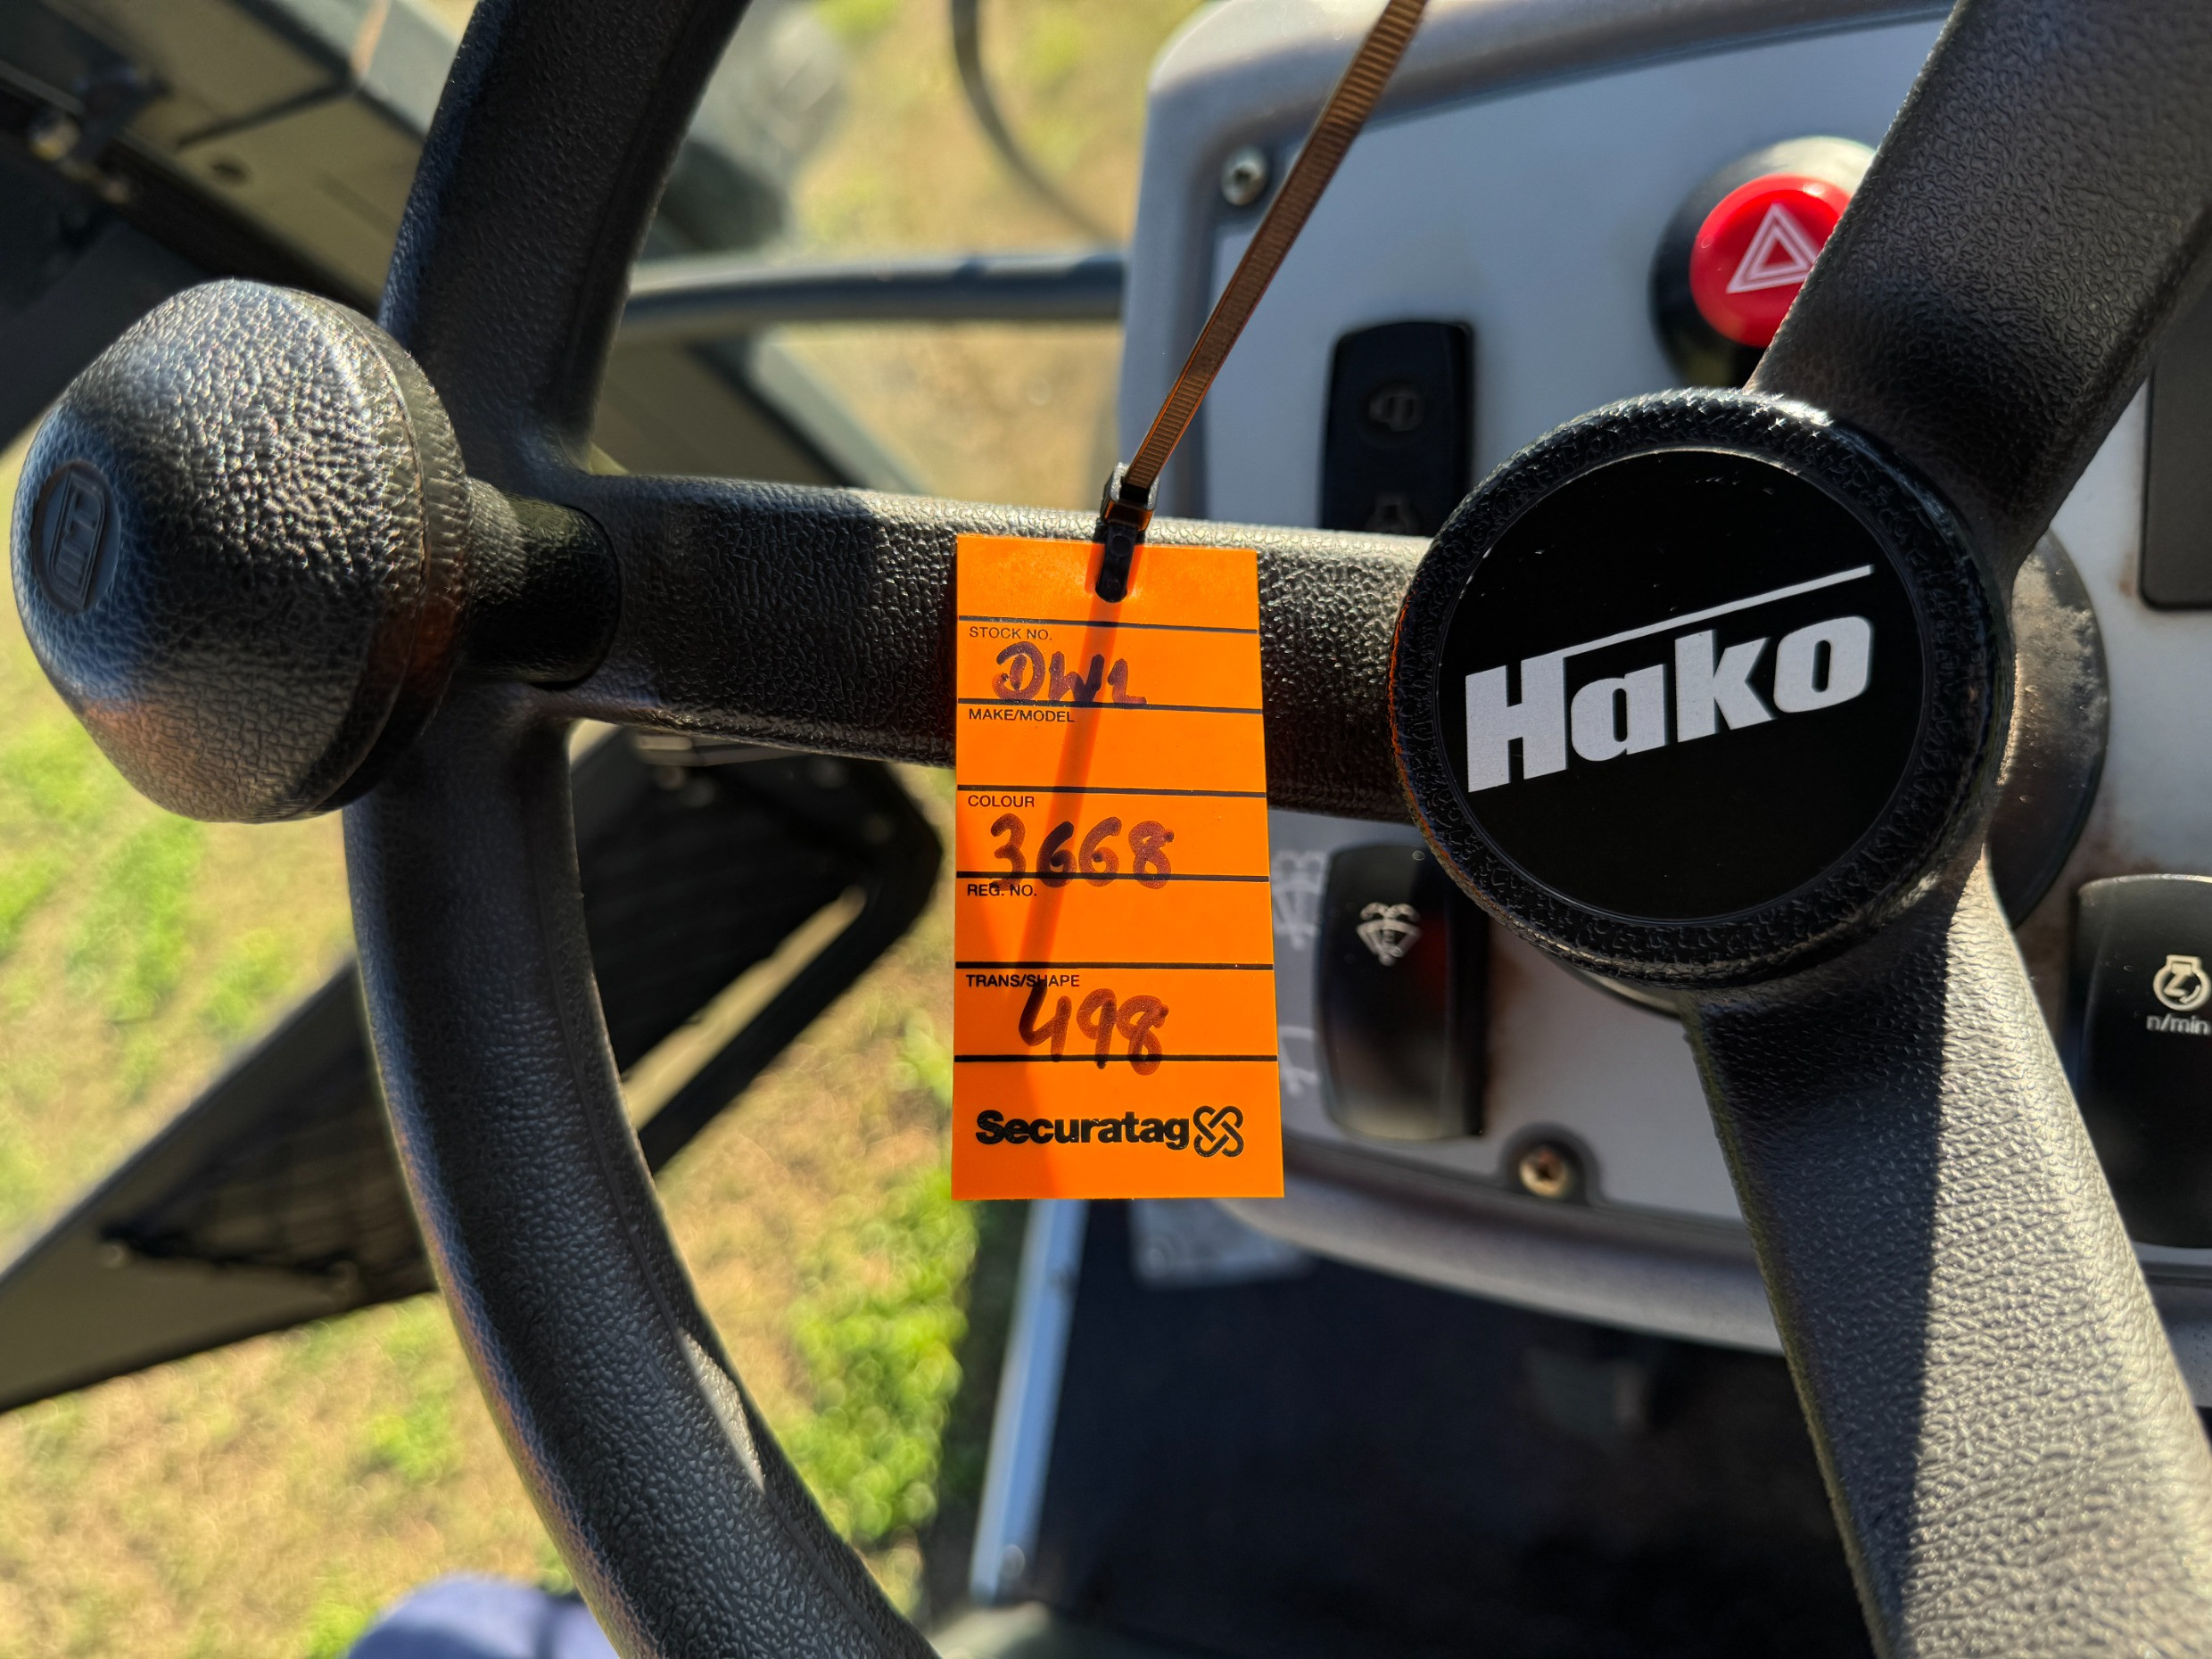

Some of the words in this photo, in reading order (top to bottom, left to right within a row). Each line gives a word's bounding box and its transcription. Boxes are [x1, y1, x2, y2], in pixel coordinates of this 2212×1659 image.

[969, 626, 1022, 640] STOCK
[1026, 628, 1053, 641] NO.
[1465, 615, 1871, 792] Hako
[968, 707, 1076, 723] MAKE/MODEL
[967, 795, 1036, 808] COLOUR
[990, 813, 1176, 890] 3668
[966, 883, 1005, 897] REG.
[1009, 883, 1038, 897] NO.
[965, 973, 1081, 988] TRANS/SHAPE
[1018, 978, 1170, 1076] 498
[2146, 1013, 2210, 1036] n/min
[975, 1109, 1190, 1150] Securatag
